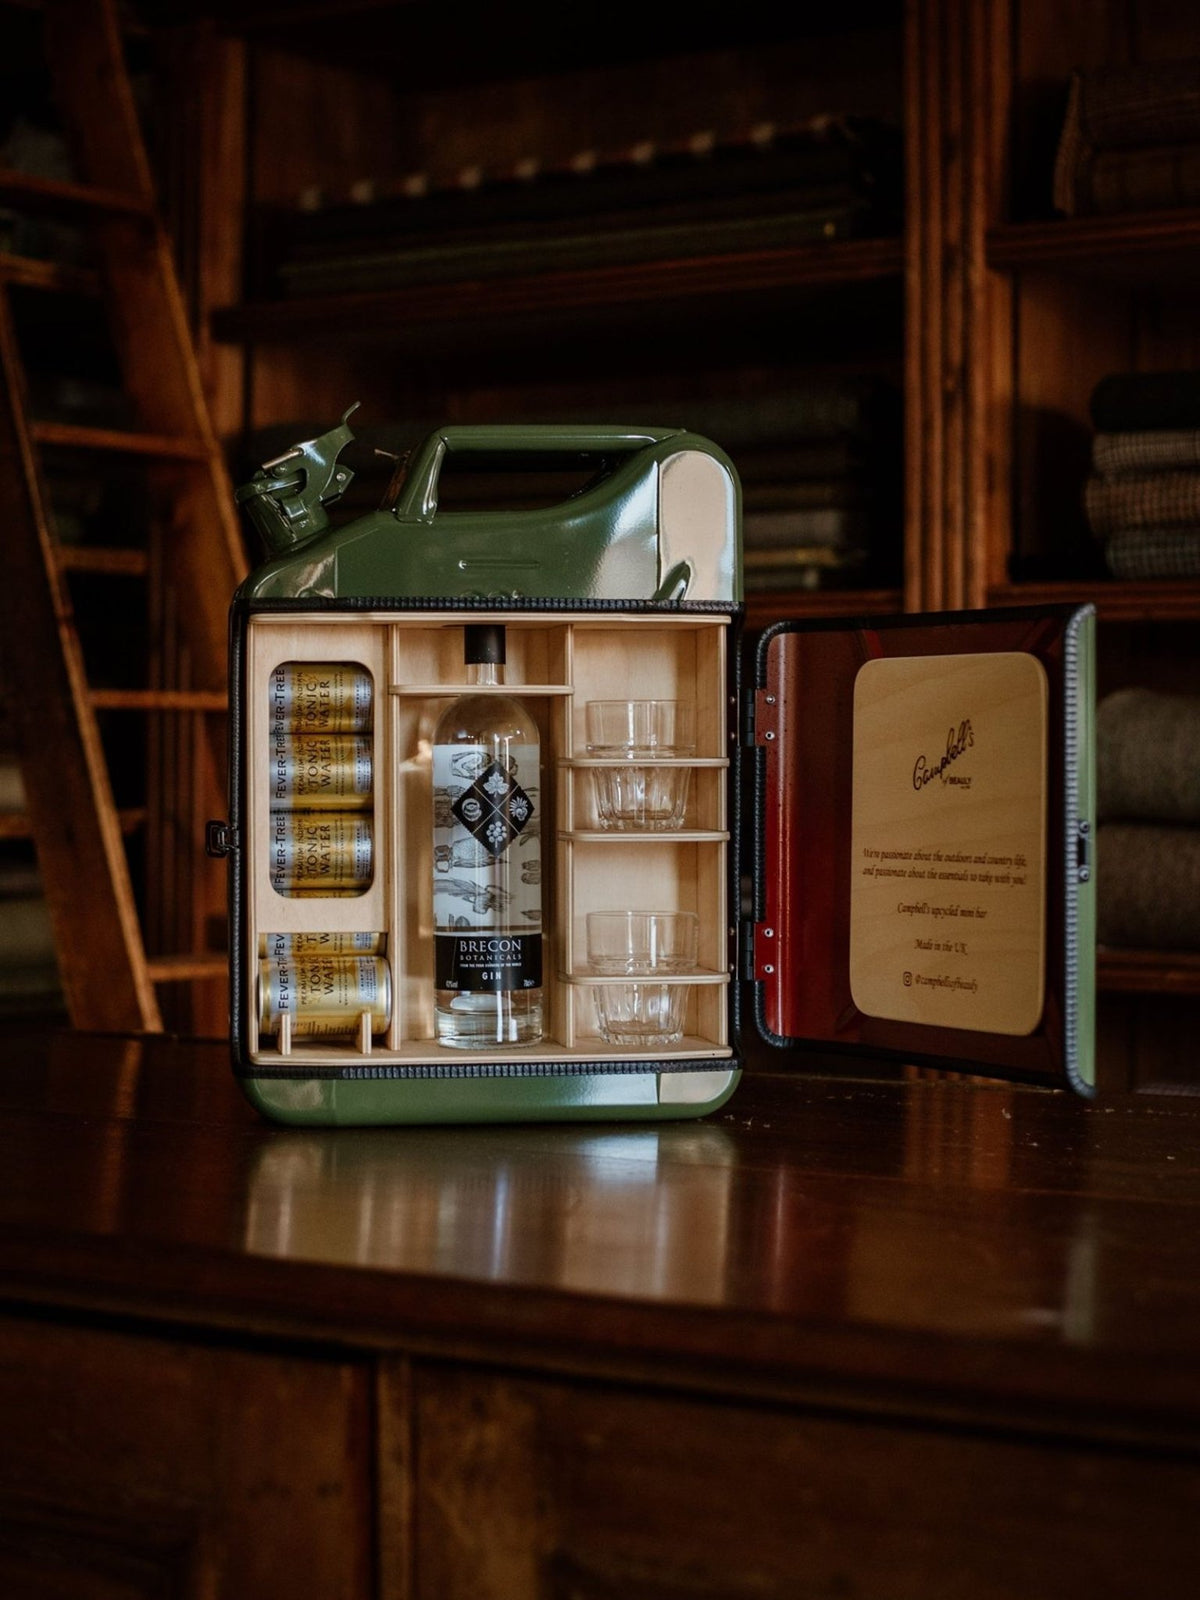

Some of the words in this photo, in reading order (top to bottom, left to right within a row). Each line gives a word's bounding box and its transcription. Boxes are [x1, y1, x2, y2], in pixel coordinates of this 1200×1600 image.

[306, 683, 317, 727] TONIC
[319, 680, 330, 728] WATER
[306, 740, 318, 787] TONIC
[319, 739, 331, 788] WATER
[275, 816, 286, 884] FEVER-TREE
[306, 827, 318, 875] TONIC
[320, 824, 331, 875] WATER
[460, 940, 521, 953] BRECON
[481, 971, 502, 980] GIN
